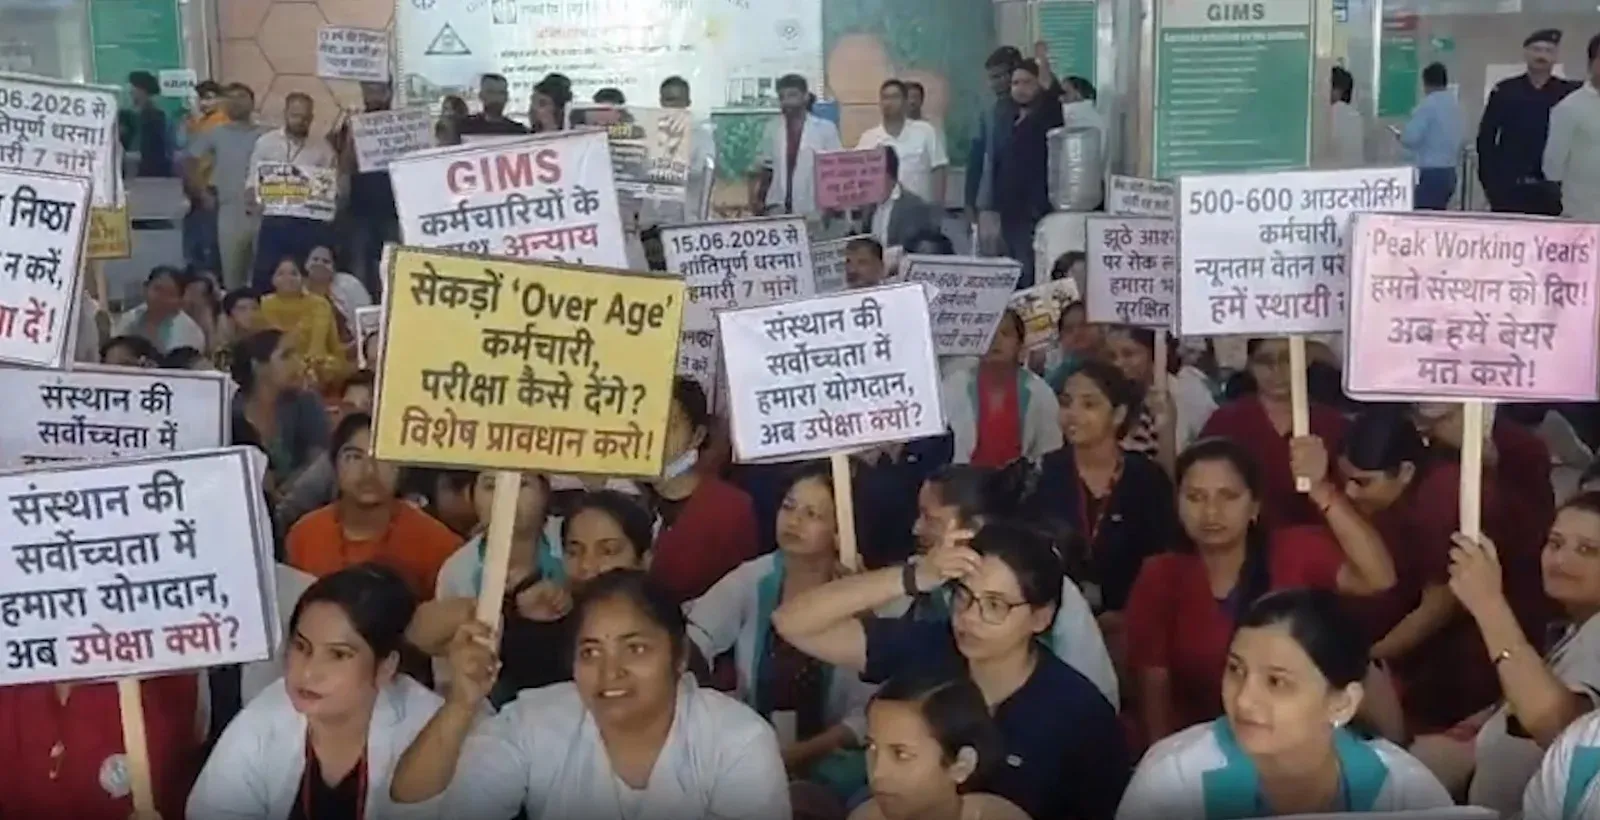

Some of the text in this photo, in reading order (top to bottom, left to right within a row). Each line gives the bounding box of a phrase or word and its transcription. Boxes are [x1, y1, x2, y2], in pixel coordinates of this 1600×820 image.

[1207, 3, 1265, 21] GIMS
[92, 96, 108, 120] से
[51, 122, 105, 146] धरना!
[33, 147, 47, 167] 7
[446, 149, 562, 195] GIMS
[11, 185, 76, 232] निष्ठा
[419, 184, 599, 236] कर्मचारियों के
[1188, 187, 1294, 216] 500-600
[503, 223, 598, 256] अन्याय
[671, 223, 799, 254] 15.06.2026 से
[1103, 223, 1133, 252] झूठे
[1259, 215, 1343, 247] कर्मचारी,
[1434, 230, 1525, 268] Working
[4, 248, 63, 291] न करें,
[680, 250, 748, 279] शांतिपूर्ण
[753, 251, 802, 270] धरना!
[1102, 255, 1122, 270] पर
[1127, 250, 1157, 271] रोक
[1194, 257, 1265, 288] न्यूनतम
[1270, 250, 1315, 279] वेतन
[686, 278, 735, 304] हमारी
[742, 280, 754, 298] 7
[1109, 277, 1154, 296] हमारा
[1209, 285, 1248, 324] हमें
[1255, 283, 1332, 319] स्थायी
[1370, 266, 1420, 303] हमने
[1426, 270, 1502, 303] संस्थान
[1508, 271, 1536, 306] को
[1543, 272, 1588, 308] दिए!
[23, 296, 56, 343] दें!
[763, 296, 883, 342] संस्थान की
[1115, 297, 1170, 322] सुरक्षित
[481, 323, 600, 373] कर्मचारी,
[1388, 310, 1556, 351] अब हमें बेयर
[765, 332, 892, 377] सर्वोच्चता में
[1417, 353, 1536, 388] मत करो!
[39, 376, 174, 415] संस्थान की
[421, 361, 648, 415] परीक्षा कैसे देंगे?
[754, 371, 914, 415] हमारा योगदान,
[37, 415, 178, 450] सर्वोच्चता में
[400, 405, 654, 462] विशेष प्रावधान करो!
[760, 399, 923, 445] अब उपेक्षा क्यों?
[8, 469, 185, 526] संस्थान की
[12, 519, 196, 574] सर्वोच्चता में
[0, 573, 229, 627] हमारा योगदान,
[6, 612, 240, 669] अब उपेक्षा क्यों?
